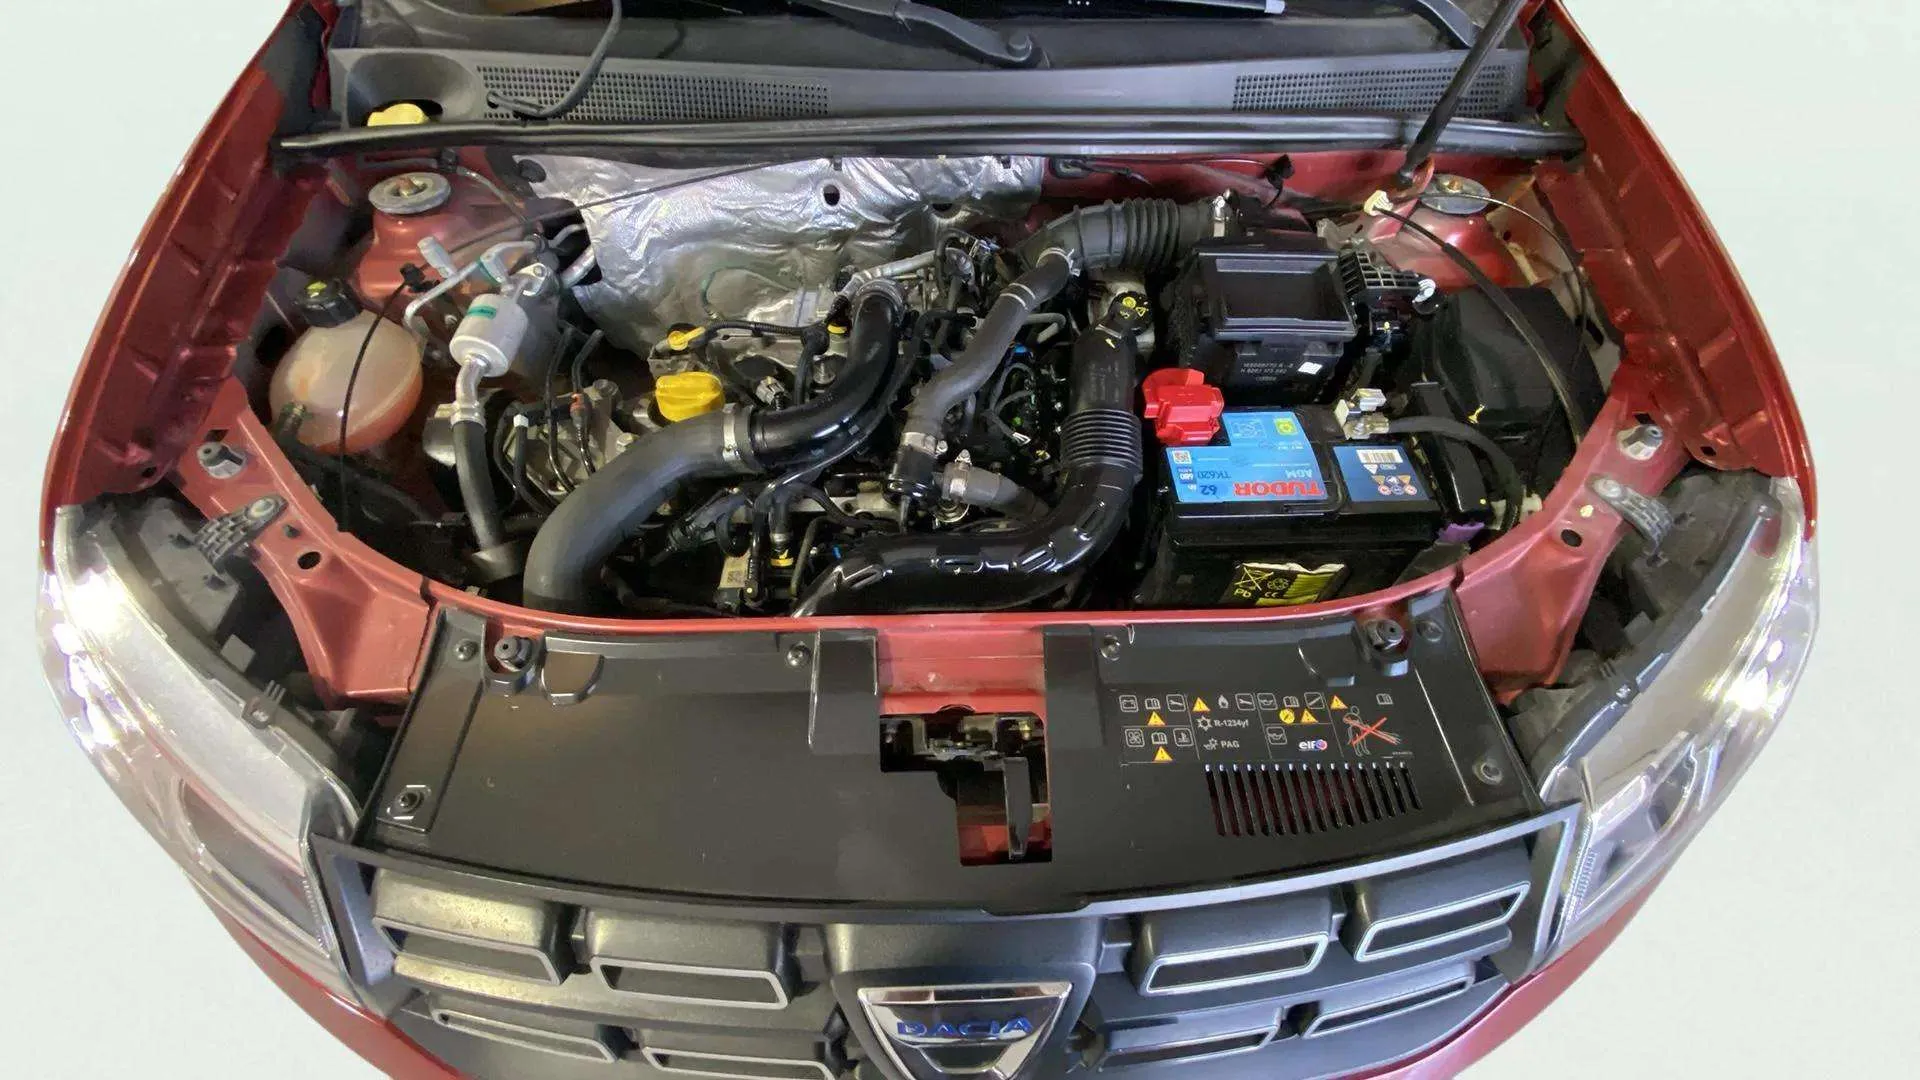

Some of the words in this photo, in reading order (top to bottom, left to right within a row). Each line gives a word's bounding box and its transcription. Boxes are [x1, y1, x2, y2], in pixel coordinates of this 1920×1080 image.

[1197, 470, 1231, 479] TK620
[1200, 484, 1218, 496] 62
[1233, 482, 1324, 497] TUDOR
[1234, 588, 1252, 598] Pb
[1214, 719, 1249, 728] R-1234yf
[1220, 740, 1240, 749] PAG
[1299, 740, 1316, 750] elf
[896, 1016, 1034, 1038] DACIA
